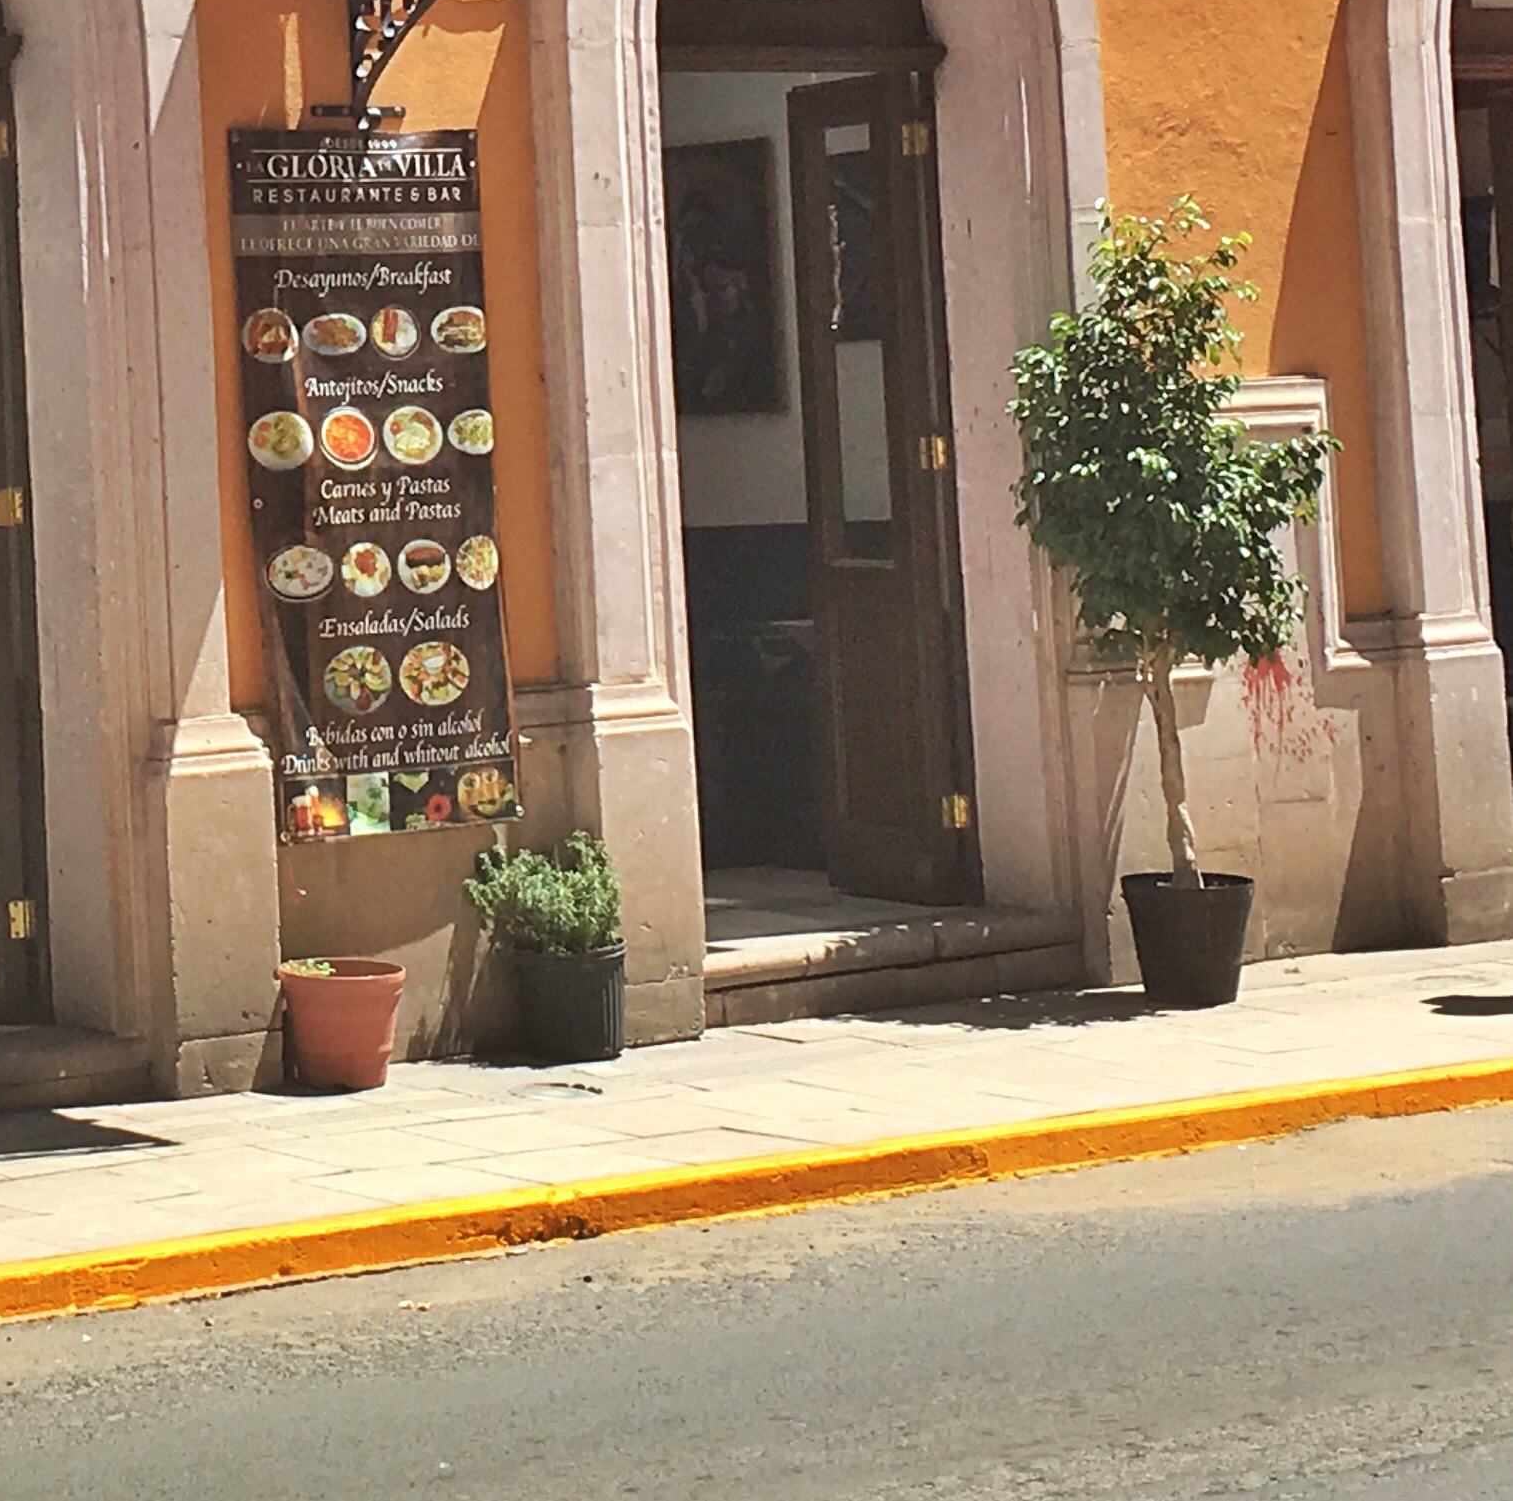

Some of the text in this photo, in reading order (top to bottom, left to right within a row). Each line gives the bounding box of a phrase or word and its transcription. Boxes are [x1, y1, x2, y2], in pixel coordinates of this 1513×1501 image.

[246, 162, 264, 173] LA
[267, 154, 377, 179] GLORIA
[393, 153, 466, 177] VILLA
[252, 186, 461, 203] RESTAURANTE & BAR
[274, 261, 452, 297] Desayunos/Breakfast
[304, 368, 443, 405] Antojitos/Snacks
[321, 475, 451, 506] Carnes y Pastas
[313, 497, 461, 526] Meats and Pastas
[318, 604, 470, 637] Ensaladas/Salads
[371, 727, 395, 742] con
[398, 728, 407, 740] o
[411, 719, 434, 738] sin
[438, 708, 485, 737] alcohol
[281, 730, 512, 774] Drinks with and whitout alcohol
